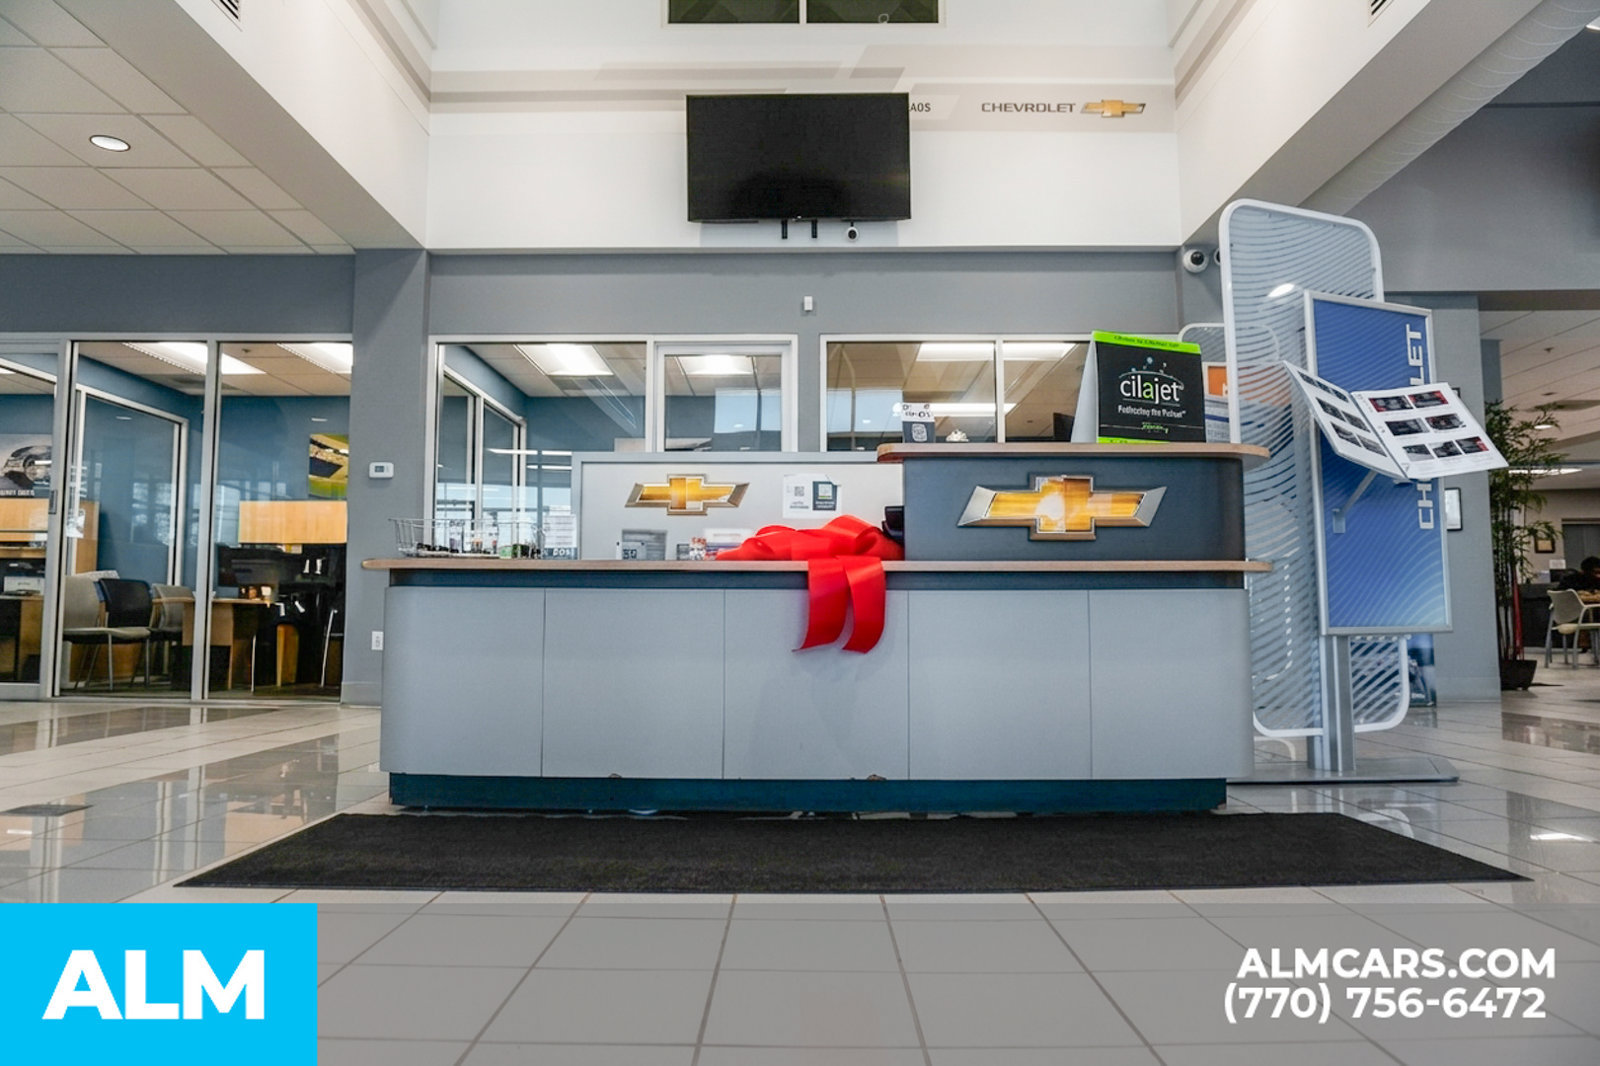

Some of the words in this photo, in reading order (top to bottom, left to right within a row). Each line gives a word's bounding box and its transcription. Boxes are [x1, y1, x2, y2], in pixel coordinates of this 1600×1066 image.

[981, 102, 1076, 113] CHEVROLET
[1119, 374, 1180, 405] cilajet
[1405, 323, 1434, 529] CHLET
